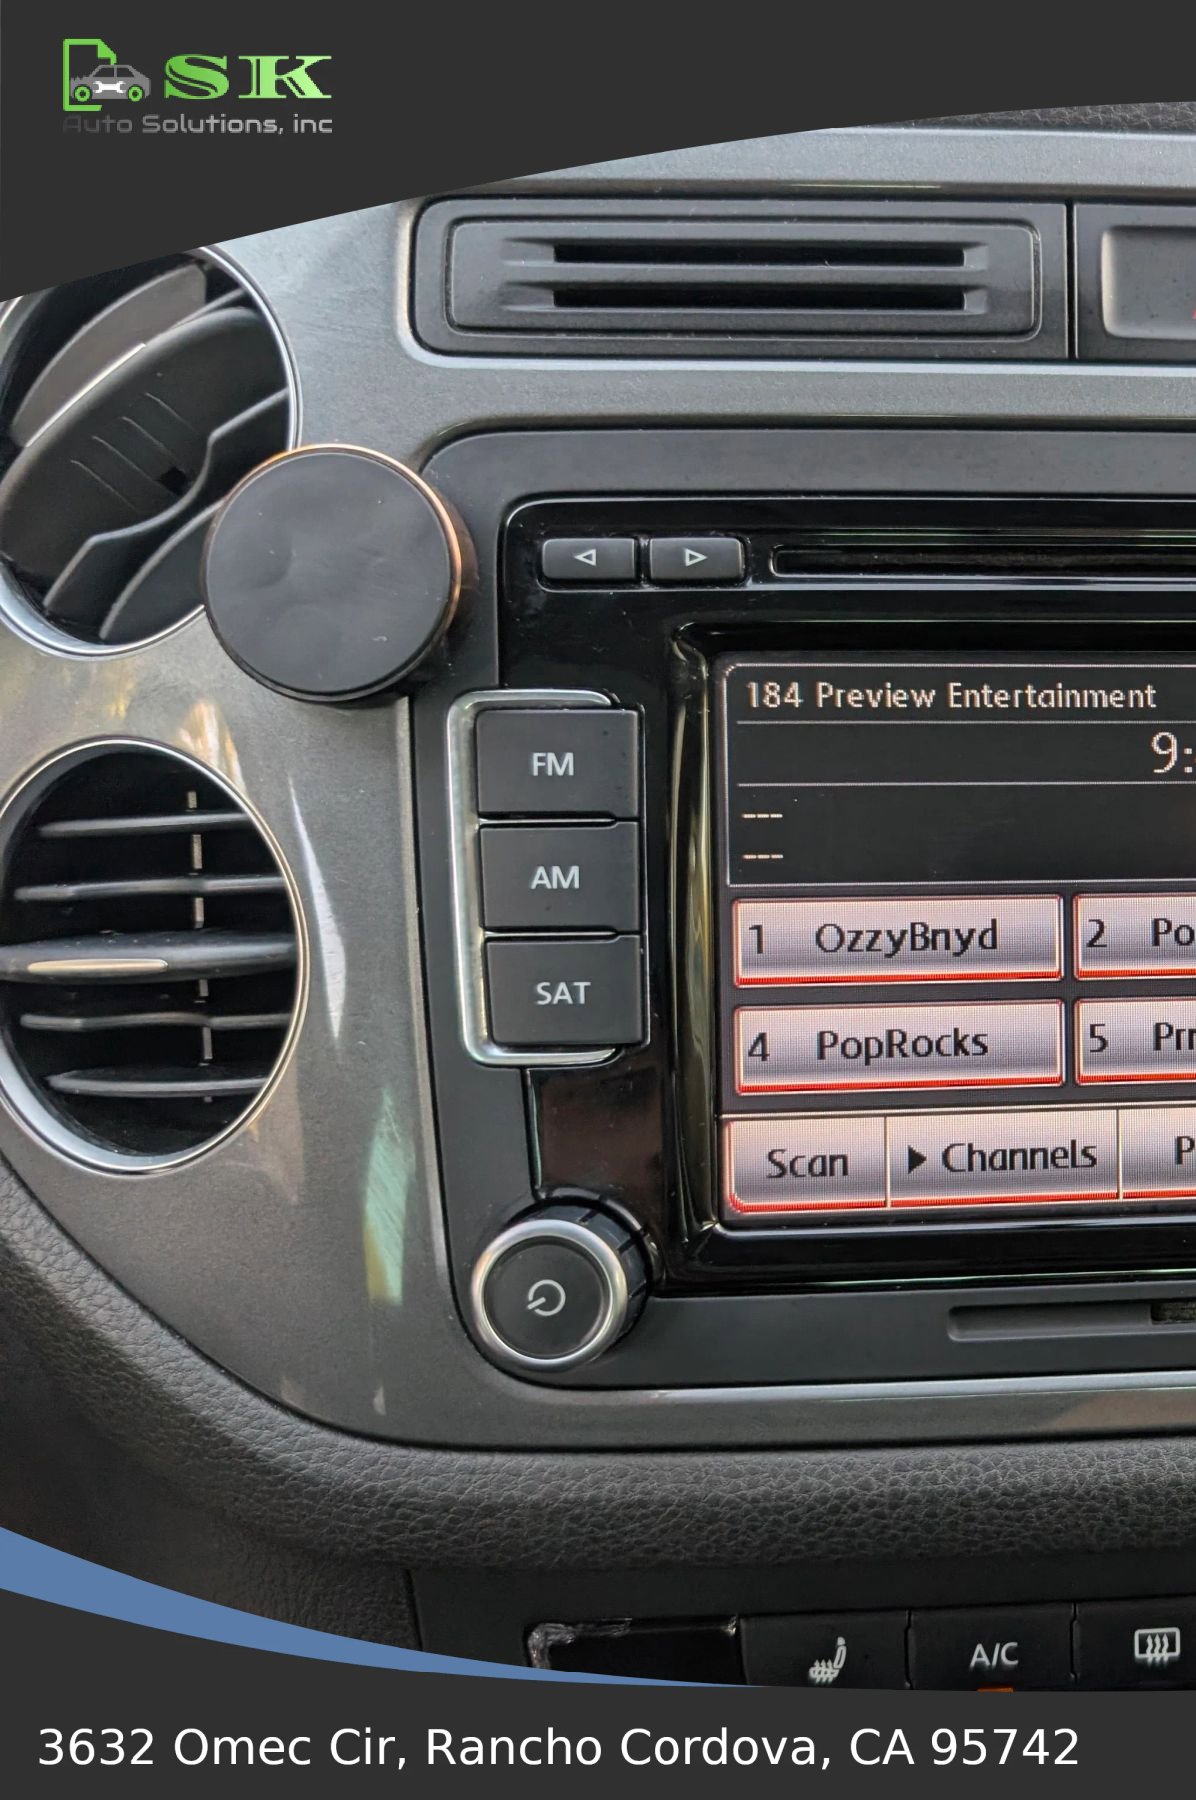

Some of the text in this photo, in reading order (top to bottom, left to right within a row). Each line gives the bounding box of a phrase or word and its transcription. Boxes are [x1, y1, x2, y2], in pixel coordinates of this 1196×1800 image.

[746, 681, 1158, 708] 184 Preview Entertainment
[531, 751, 575, 777] FM
[530, 865, 581, 890] AM
[747, 918, 1000, 958] 1 OzzyBnyd
[1085, 918, 1108, 949] 2
[534, 980, 592, 1006] SAT
[747, 1027, 990, 1066] 4 PopRocks
[1088, 1023, 1109, 1054] 5
[765, 1148, 850, 1179] Scan
[941, 1139, 1098, 1174] Channels
[969, 1640, 1019, 1670] A/C
